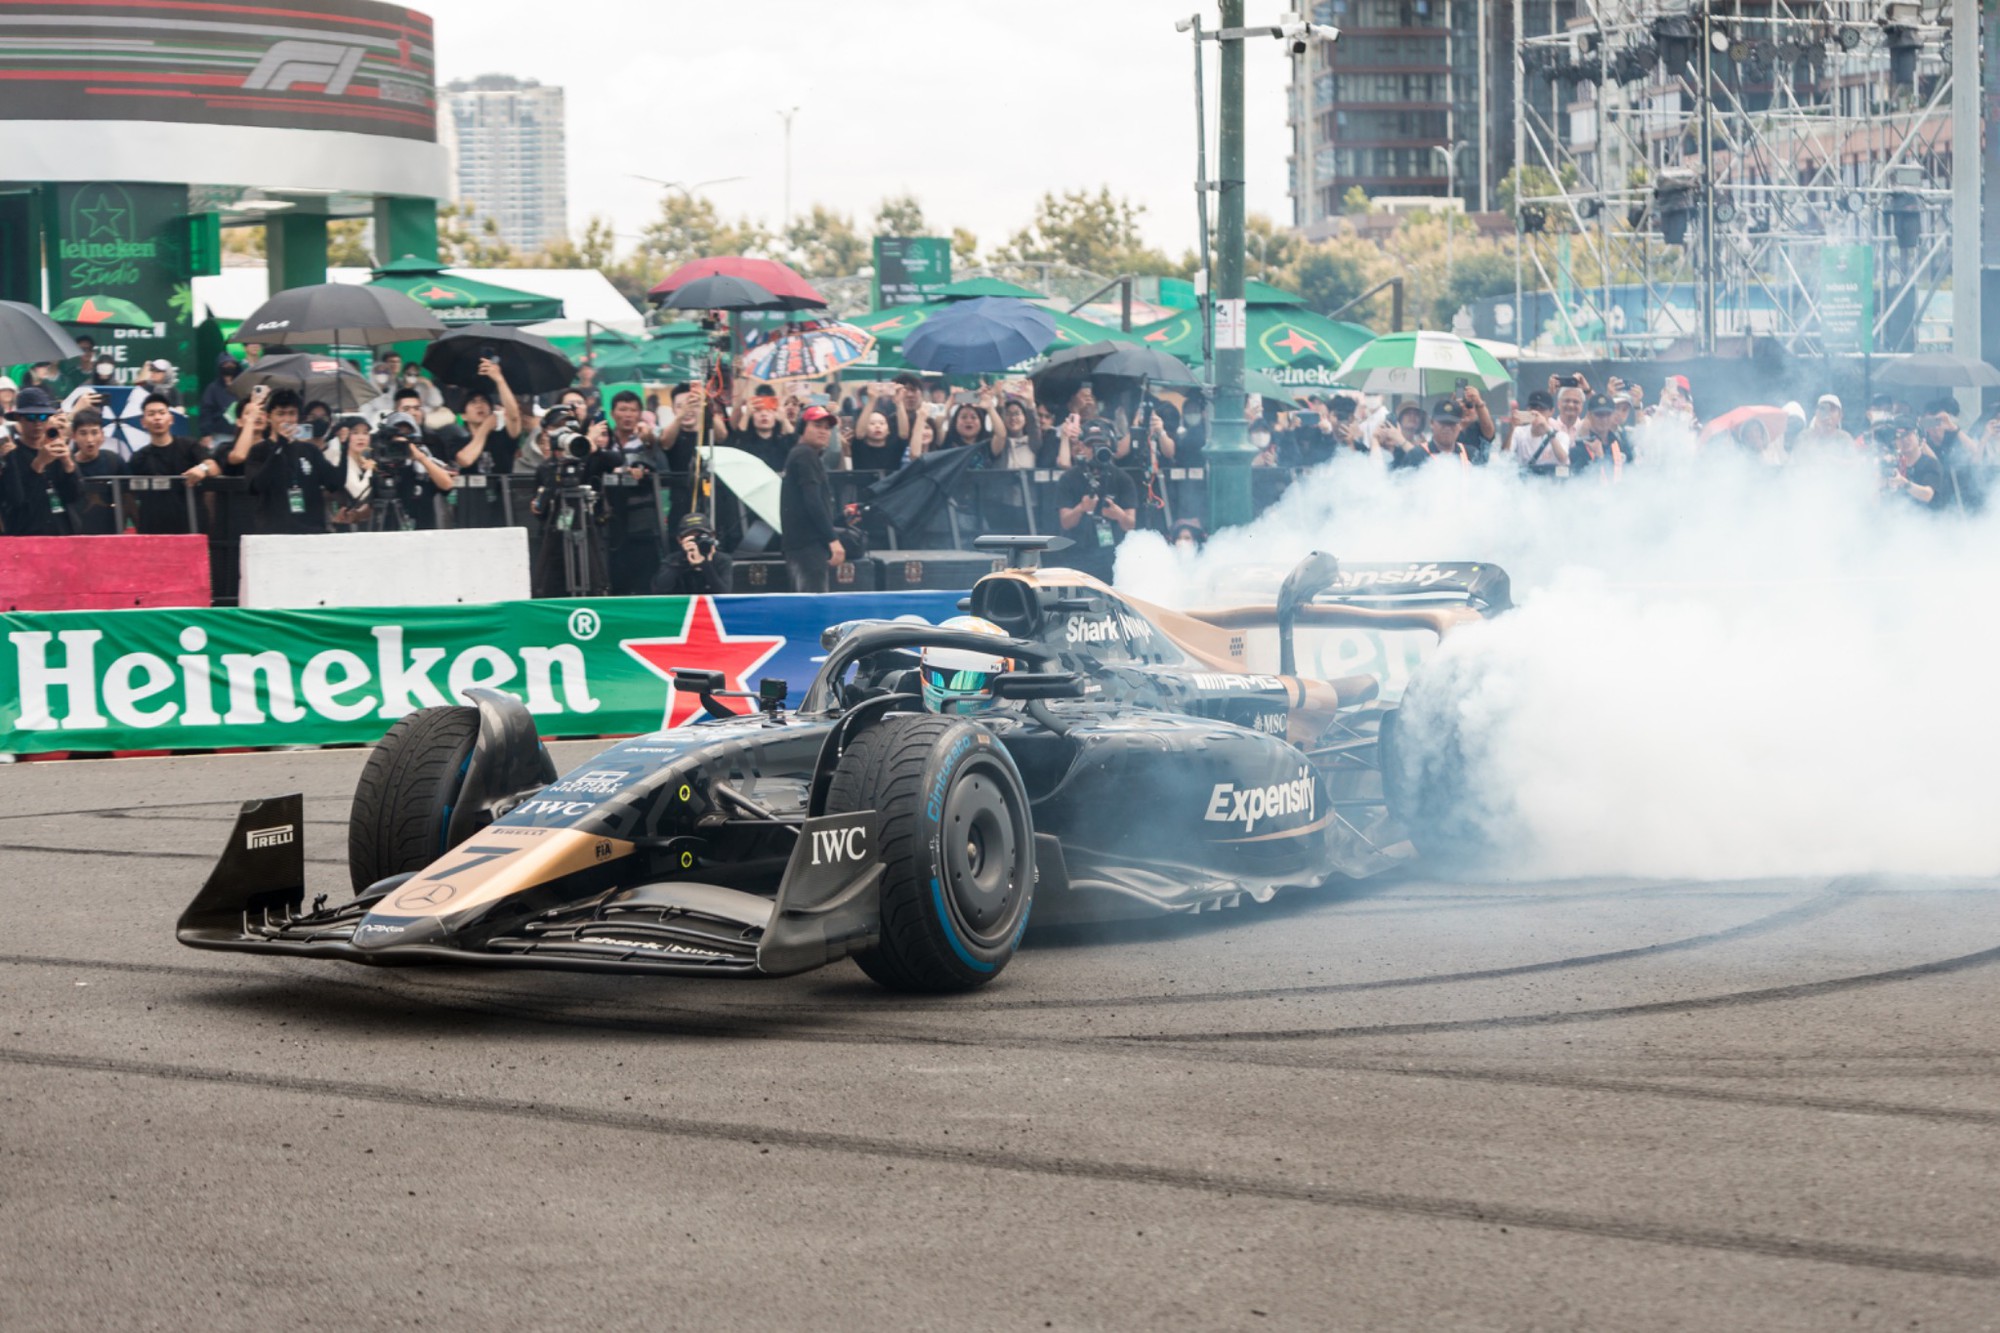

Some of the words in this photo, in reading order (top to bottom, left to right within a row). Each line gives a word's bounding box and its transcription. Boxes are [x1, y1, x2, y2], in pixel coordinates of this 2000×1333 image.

[241, 40, 367, 95] F1
[69, 262, 140, 288] Studio
[1066, 613, 1120, 643] Shark
[9, 625, 600, 730] Heineken
[1263, 713, 1287, 734] MSC
[515, 800, 596, 816] IWC
[1204, 765, 1316, 833] Expensify
[246, 824, 294, 850] PIRELLI
[491, 828, 548, 836] PIRELLI
[811, 826, 867, 865] IWC
[423, 846, 523, 881] 7
